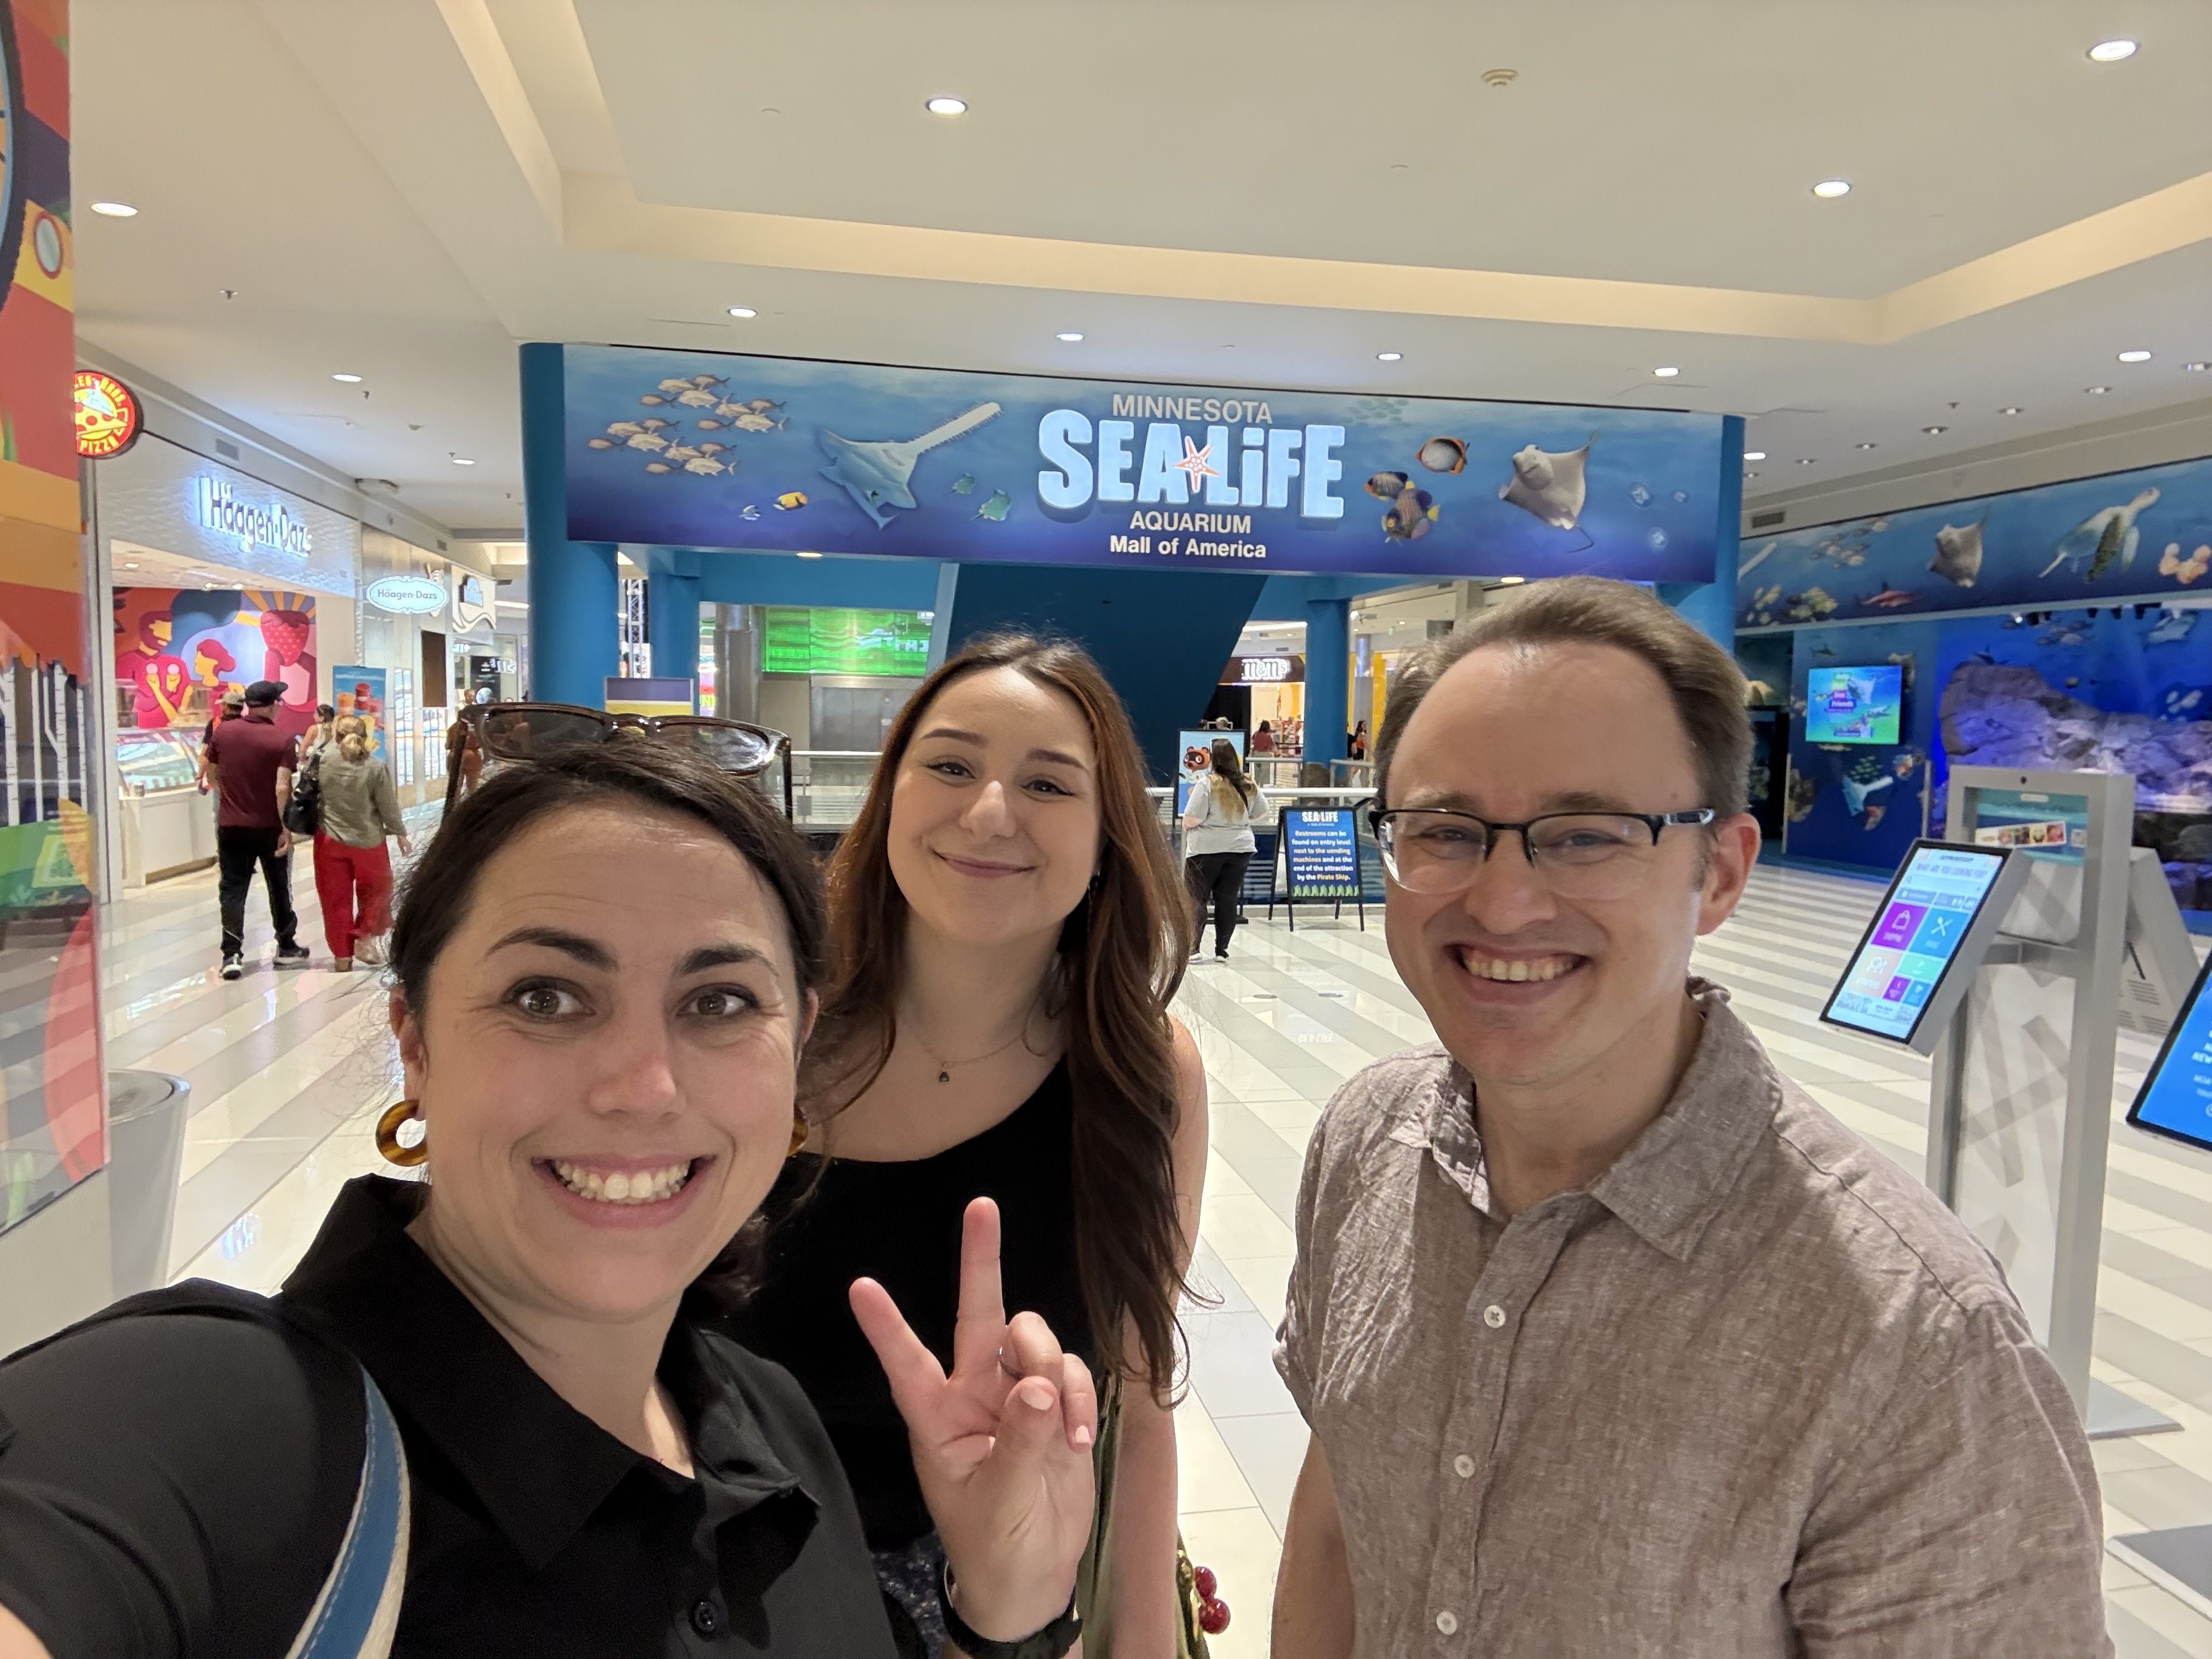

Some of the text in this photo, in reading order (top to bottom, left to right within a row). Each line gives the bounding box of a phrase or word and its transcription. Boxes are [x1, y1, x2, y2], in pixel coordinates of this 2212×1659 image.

[1113, 393, 1273, 425] MINNESOTA
[1038, 409, 1189, 510] SEA
[1130, 510, 1251, 534] AQUARIUM
[1110, 535, 1266, 558] Mall of America
[377, 589, 438, 600] Häagen-Dazs
[1302, 811, 1319, 822] SEA
[1335, 873, 1351, 882] Ship.
